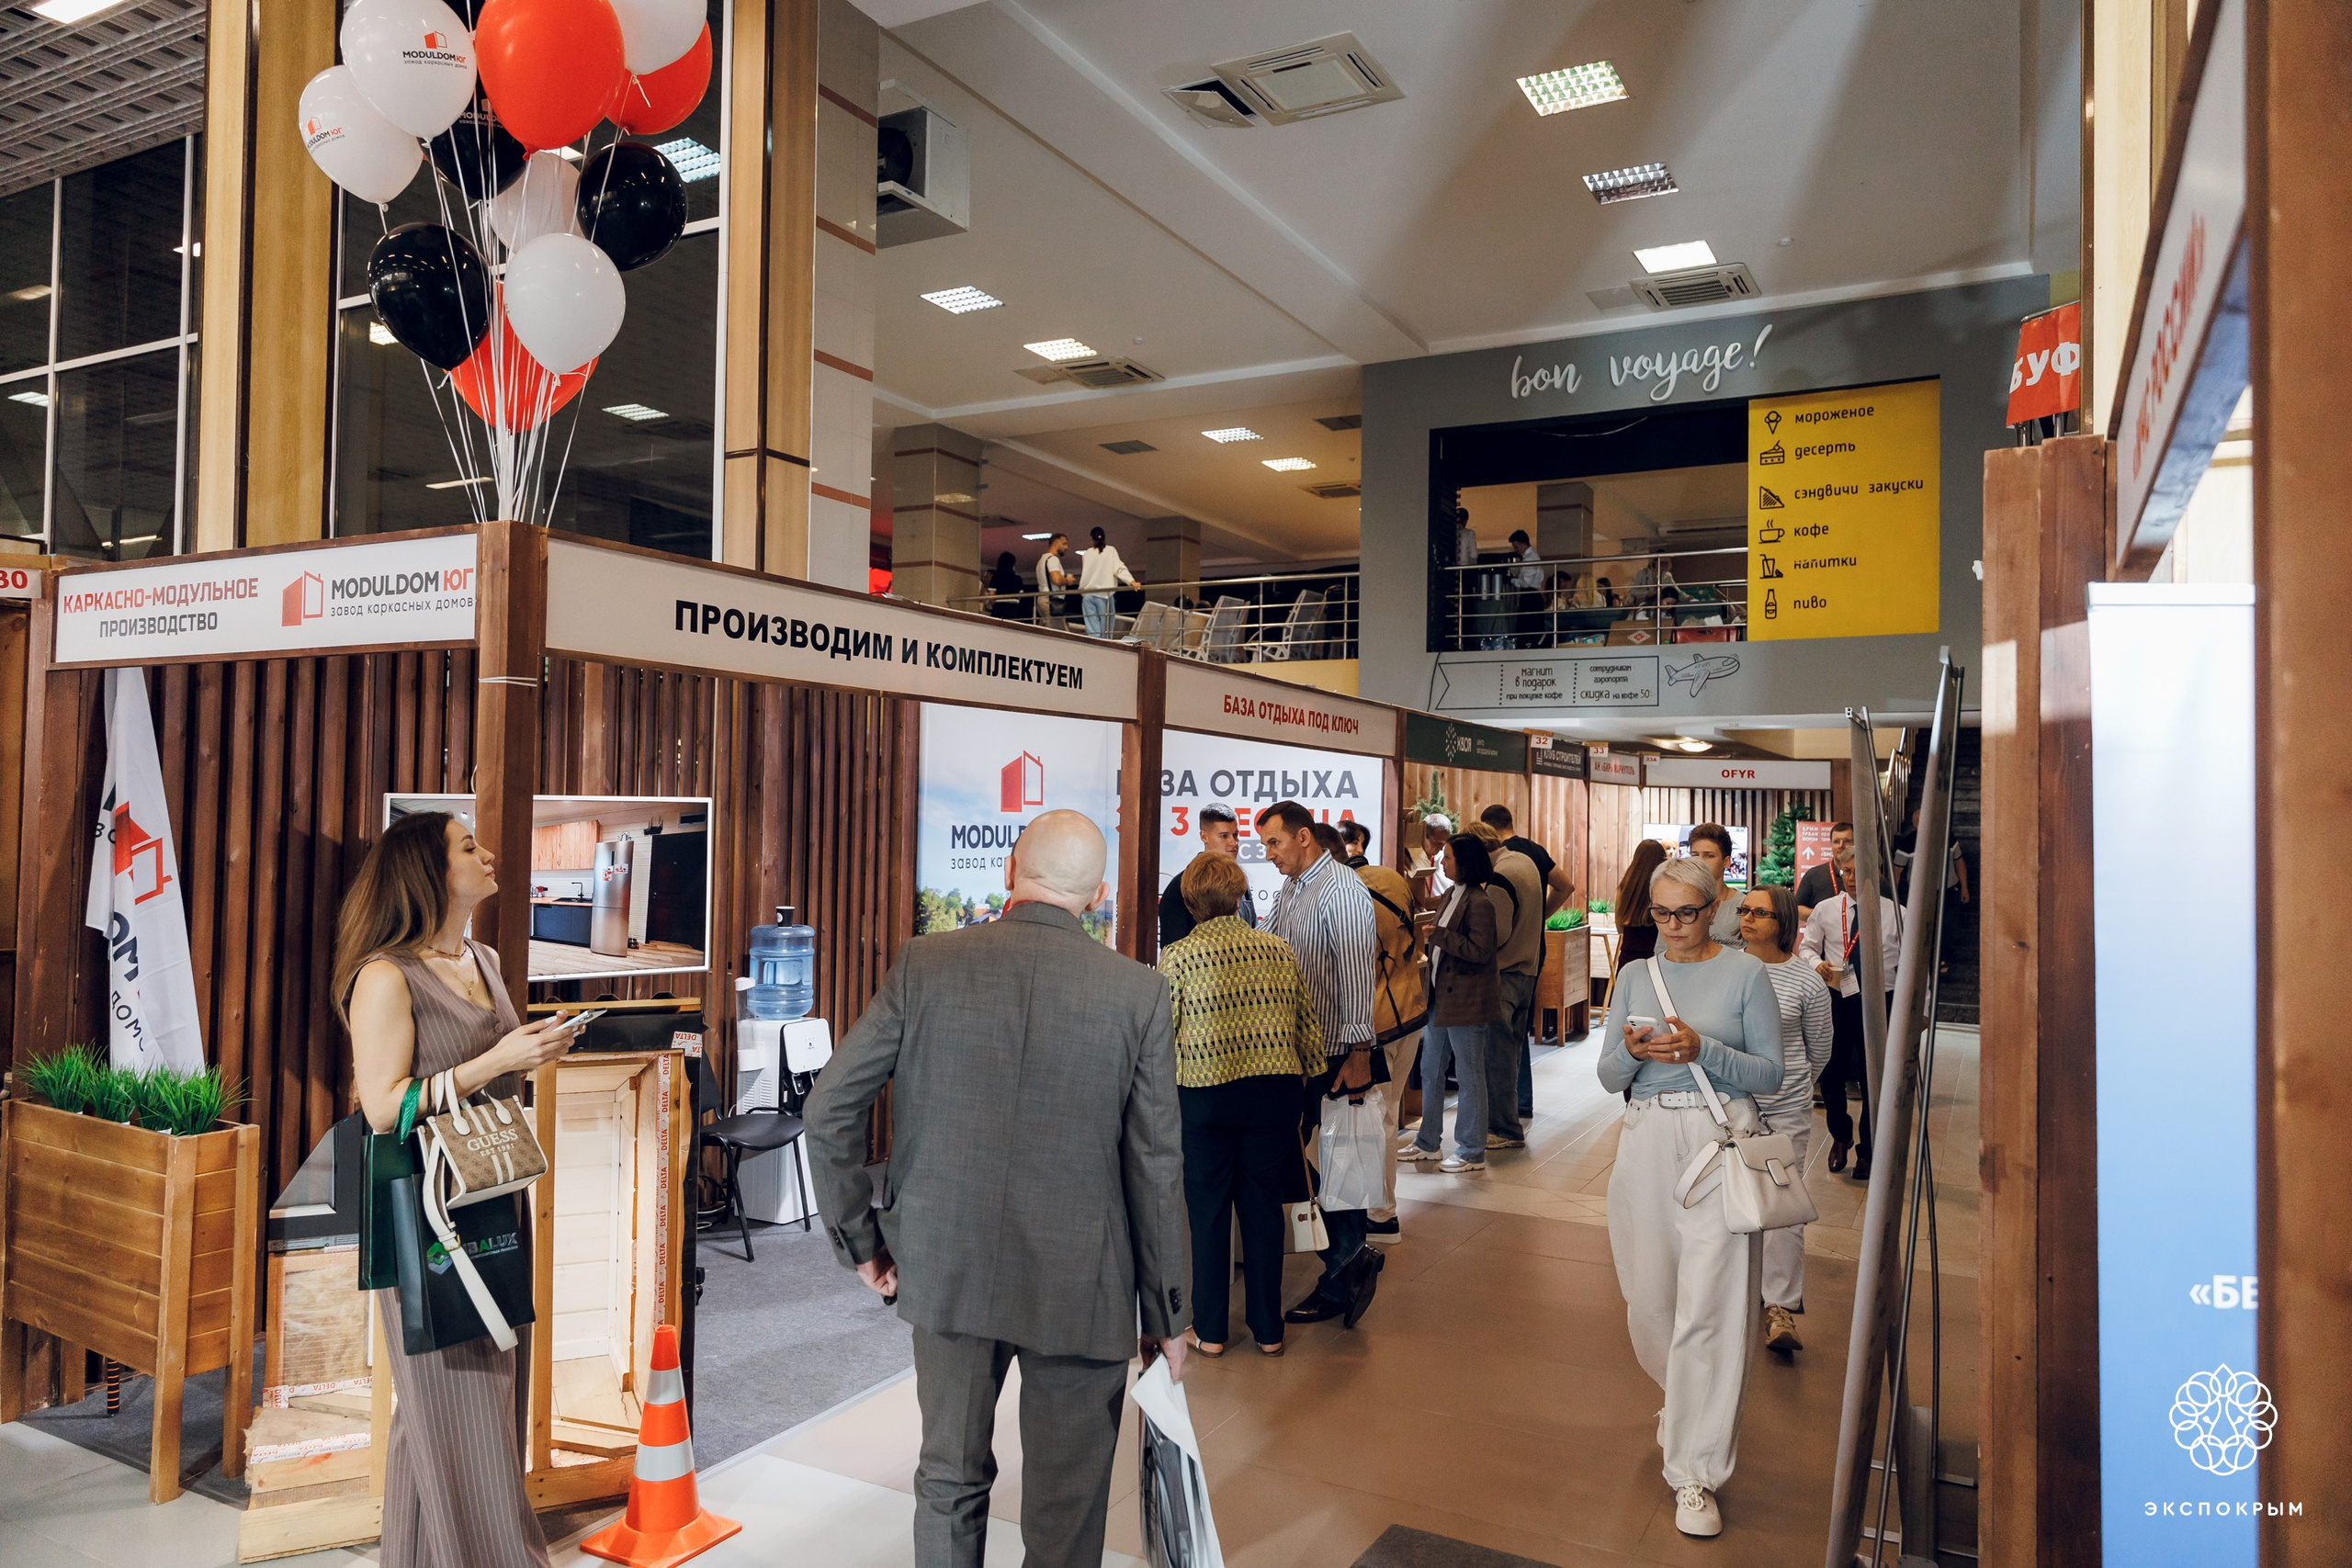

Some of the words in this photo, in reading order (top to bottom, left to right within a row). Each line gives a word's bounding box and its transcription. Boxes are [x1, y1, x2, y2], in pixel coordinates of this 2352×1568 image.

[402, 51, 456, 62] MODULDOM
[1511, 355, 1581, 399] bon
[1610, 323, 1773, 401] voyage!
[1795, 406, 1874, 424] мороженое
[1794, 483, 1859, 500] сэндвичи
[1869, 479, 1924, 494] закуски
[1793, 523, 1829, 538] кофе
[1793, 557, 1857, 570] напитки
[331, 570, 439, 600] MODULDOM
[443, 568, 474, 592] ЮГ
[62, 577, 259, 614] КАРКАСНО-МОДУЛЬНОЕ
[1793, 595, 1826, 609] пиво
[331, 603, 364, 617] завод
[368, 599, 432, 616] каркасных
[435, 597, 474, 611] домов
[99, 611, 219, 638] ПРОИЗВОДСТВО
[675, 599, 892, 662] ПРОИЗВОДИМ
[902, 637, 919, 665] И
[926, 641, 1084, 690] КОМПЛЕКТУЕМ
[1521, 667, 1553, 676] магнит
[1589, 665, 1632, 673] сотрудникам
[1515, 675, 1521, 687] в
[1522, 679, 1556, 691] подарок
[1594, 676, 1628, 684] аэропорта
[1544, 692, 1563, 700] кофе
[1580, 690, 1610, 701] скидка
[1622, 692, 1638, 700] кофе
[1223, 694, 1255, 717] БАЗА
[1259, 702, 1305, 727] ОТДЫХА
[1307, 711, 1329, 733] ПОД
[1331, 715, 1359, 735] КЛЮЧ
[1535, 737, 1548, 745] 32
[1721, 769, 1756, 780] OFYR
[1210, 770, 1359, 802] ОТДЫХА
[951, 825, 1025, 849] MODUL
[951, 857, 986, 870] завод
[675, 1032, 696, 1041] DELTA
[467, 1128, 518, 1151] GUESS
[480, 1147, 495, 1156] EST
[497, 1143, 515, 1152] 1981
[312, 1382, 335, 1391] DELTA
